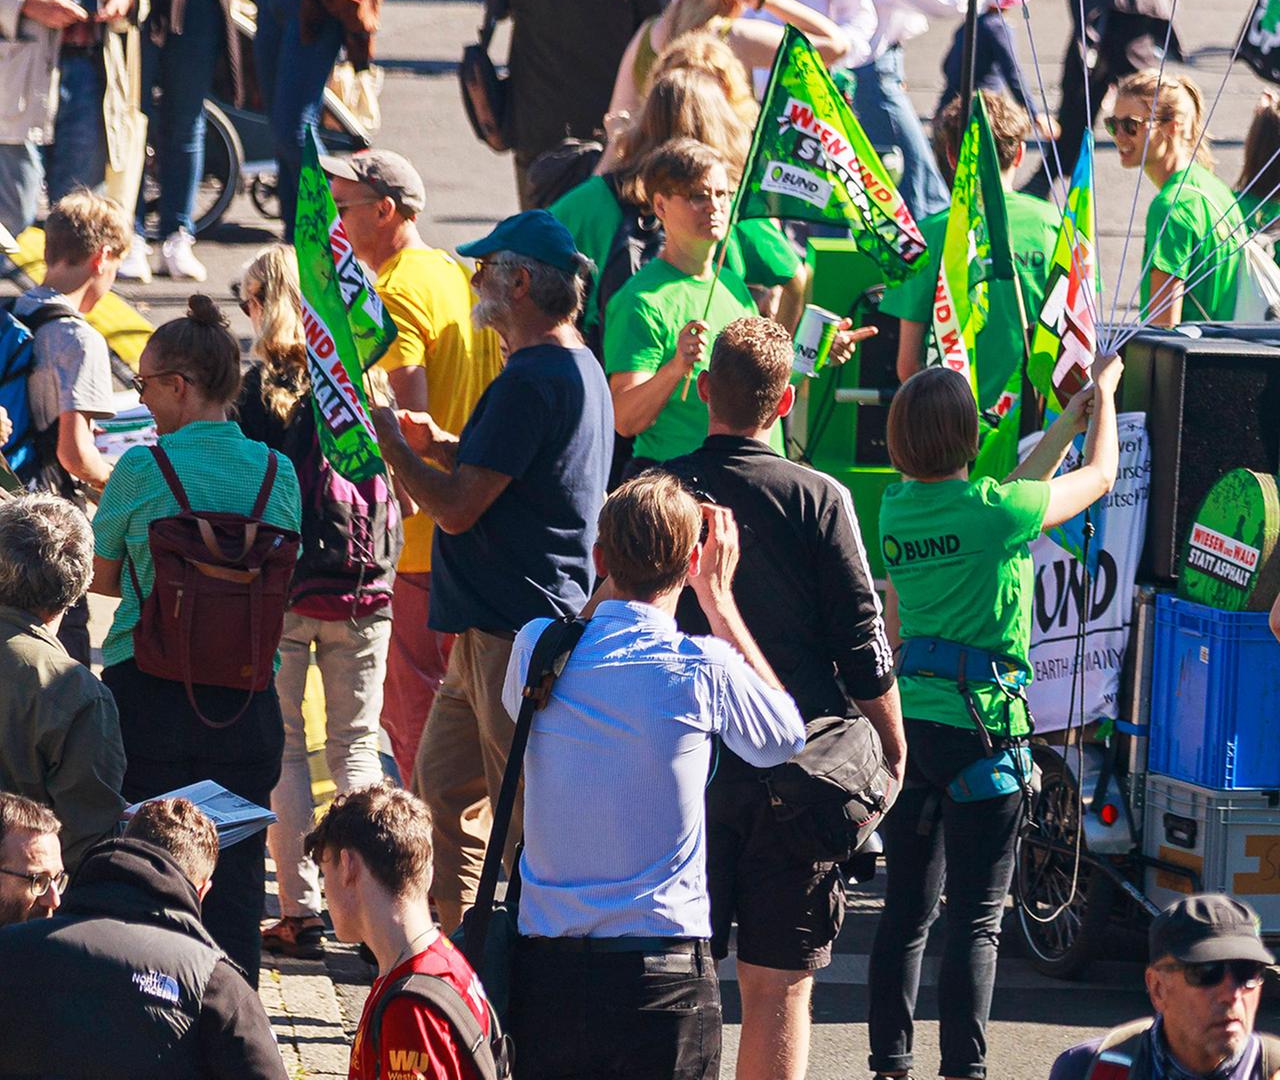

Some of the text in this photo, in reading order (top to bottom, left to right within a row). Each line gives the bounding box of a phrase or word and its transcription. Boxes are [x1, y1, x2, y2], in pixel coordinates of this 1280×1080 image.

[781, 171, 819, 194] BUND
[903, 533, 961, 561] BUND
[1193, 526, 1226, 552] WIESEN
[1233, 544, 1258, 568] WALD
[1187, 547, 1252, 588] STATT ASPHALT
[1034, 657, 1069, 682] EARTH
[131, 972, 164, 991] NORTH
[388, 1049, 429, 1073] WU
